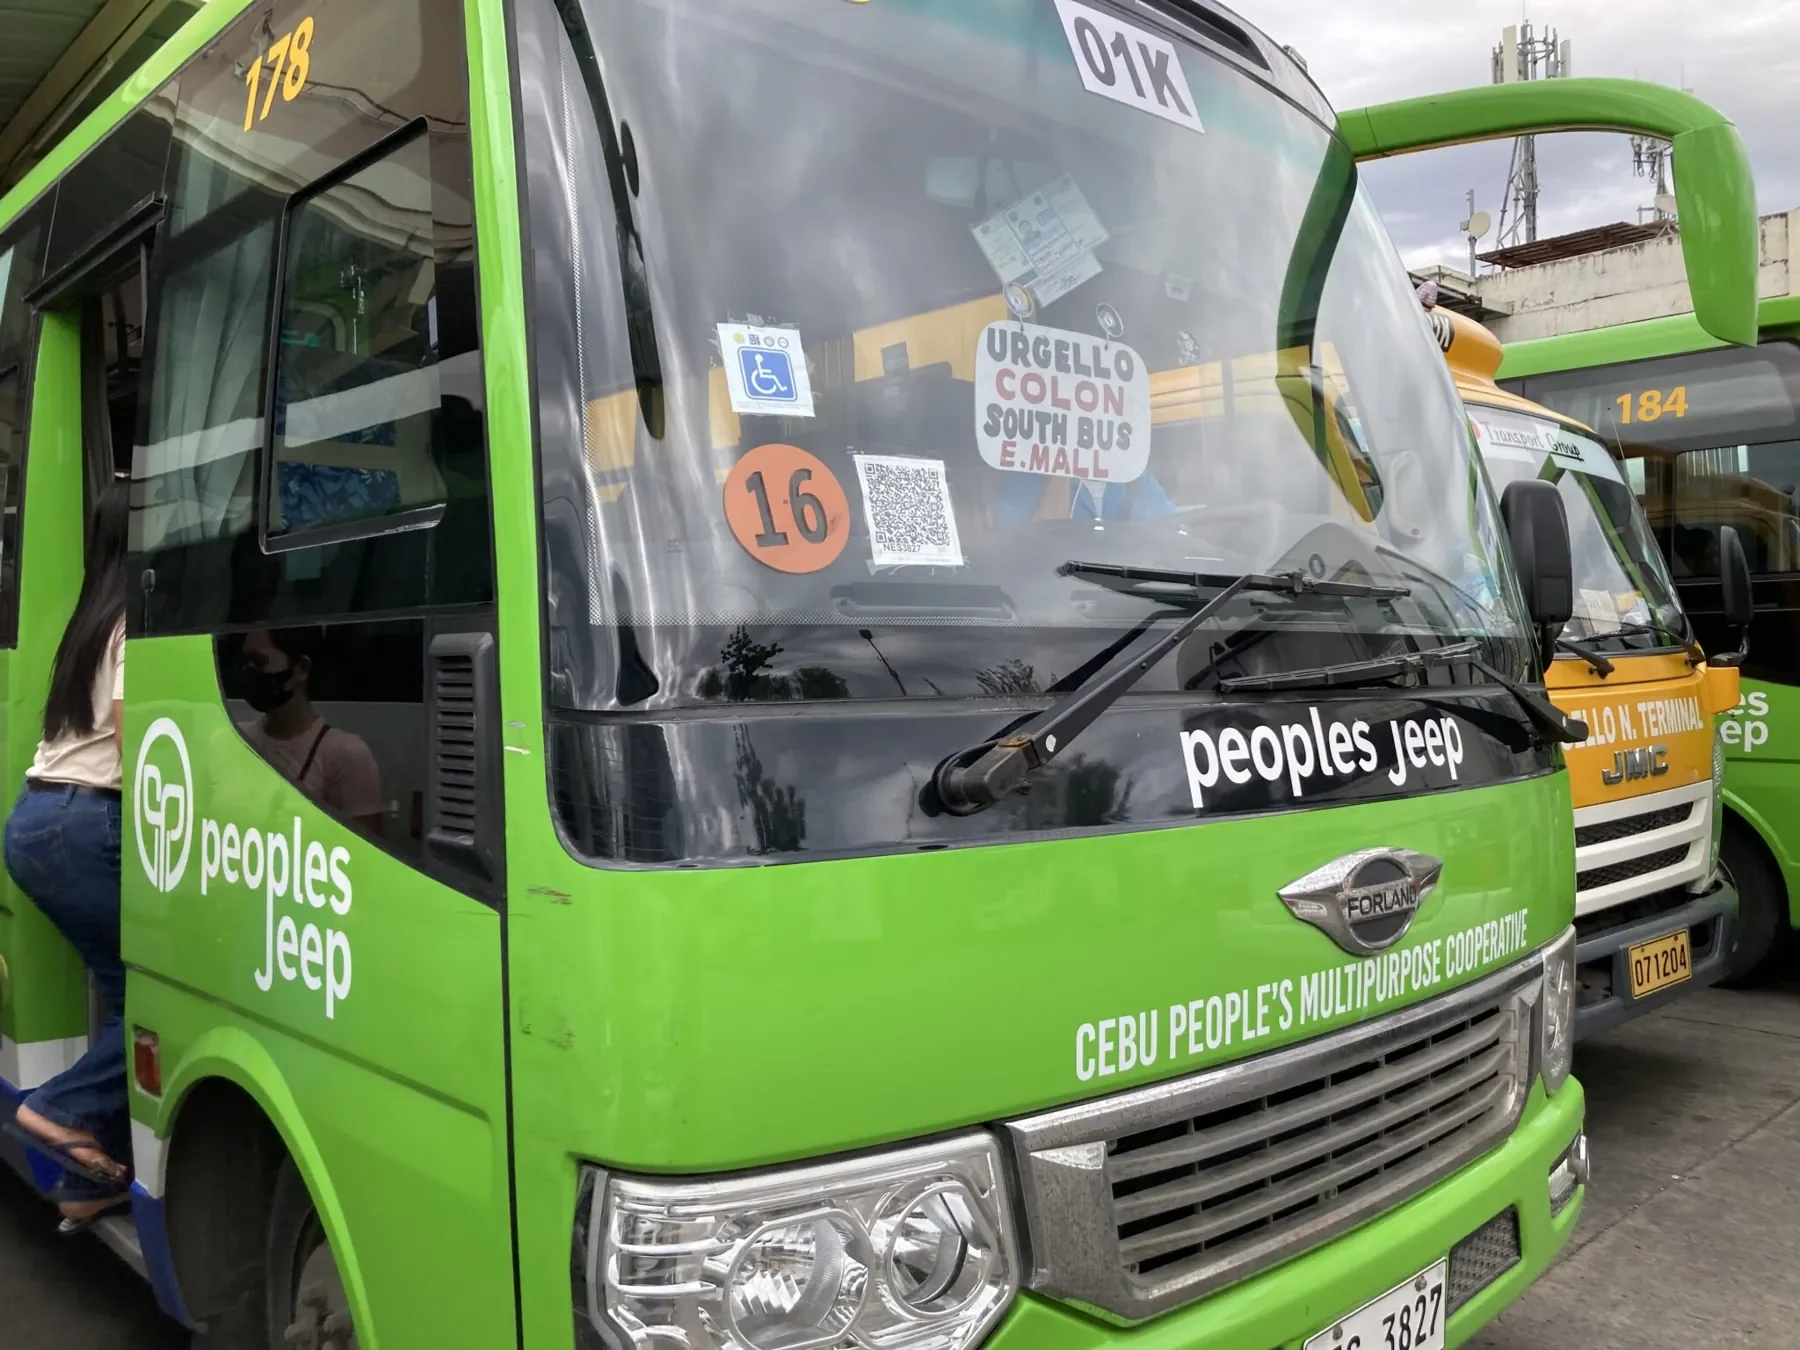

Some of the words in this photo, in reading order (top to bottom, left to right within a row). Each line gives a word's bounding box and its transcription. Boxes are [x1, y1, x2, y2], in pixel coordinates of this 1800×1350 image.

[243, 16, 314, 132] 178
[1073, 16, 1192, 118] 01K
[986, 327, 1134, 382] URGELLO
[995, 368, 1124, 416] COLON
[1616, 385, 1688, 424] 184
[983, 403, 1068, 445] SOUTH
[1077, 416, 1133, 450] BUS
[1480, 421, 1545, 450] Transport
[1545, 432, 1581, 462] Group
[1000, 440, 1109, 478] E.MALL
[745, 468, 828, 547] 16
[883, 543, 921, 553] NES3827
[1618, 704, 1637, 742] N.
[1637, 697, 1703, 738] TERMINAL
[1180, 707, 1378, 808] peoples
[1388, 716, 1463, 786] jeep
[1602, 744, 1669, 786] JMC
[201, 816, 352, 916] peoples
[1347, 884, 1417, 919] FORLAND
[254, 905, 352, 1019] jeep
[1634, 943, 1687, 987] 071204
[1076, 1009, 1158, 1082] CEBU
[1169, 979, 1293, 1060] PEOPLE'S
[1300, 939, 1441, 1025] MULTIPURPOSE
[1445, 907, 1528, 978] COOPERATIVE
[1382, 1282, 1442, 1350] 3827
